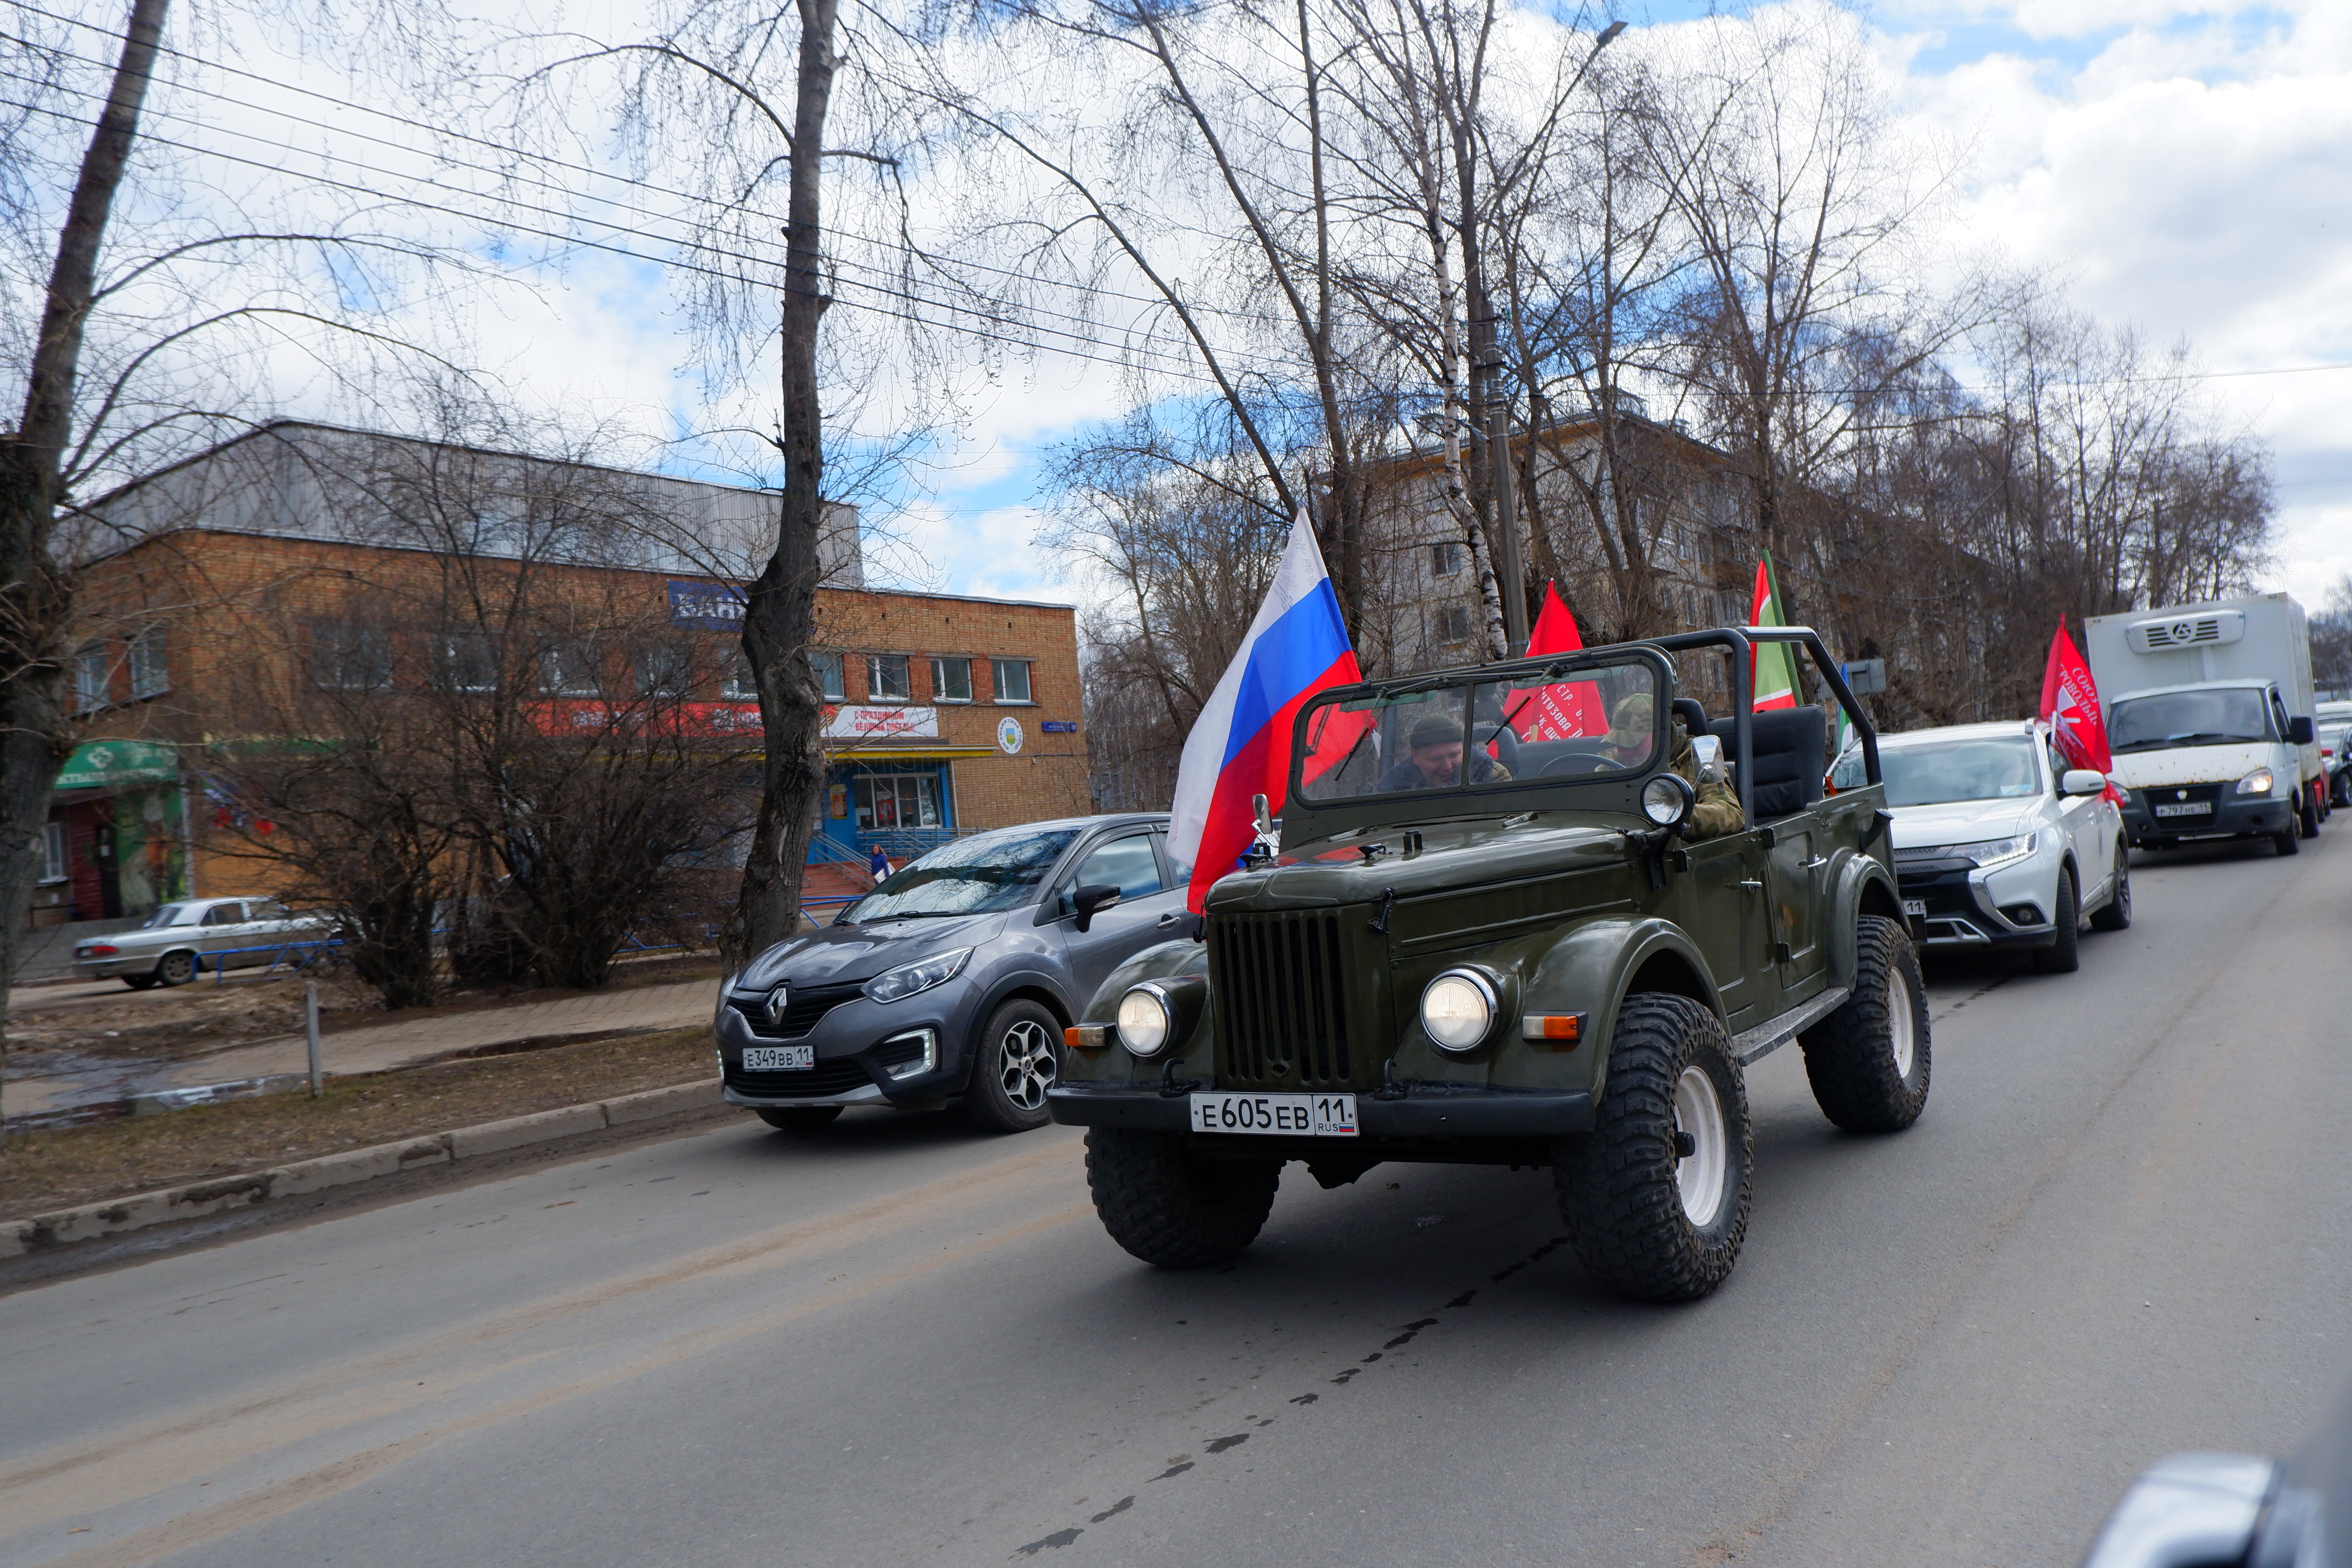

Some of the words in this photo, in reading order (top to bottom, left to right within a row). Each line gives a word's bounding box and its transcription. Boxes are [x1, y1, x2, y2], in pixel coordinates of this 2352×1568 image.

[1556, 684, 1573, 706] СТР.
[854, 711, 858, 720] С
[1907, 902, 1921, 912] 11
[748, 1049, 793, 1067] Е349ВВ
[797, 1047, 809, 1060] 11
[1202, 1098, 1310, 1130] Е605ЕВ
[1318, 1098, 1345, 1122] 11
[1318, 1123, 1339, 1132] RUS
